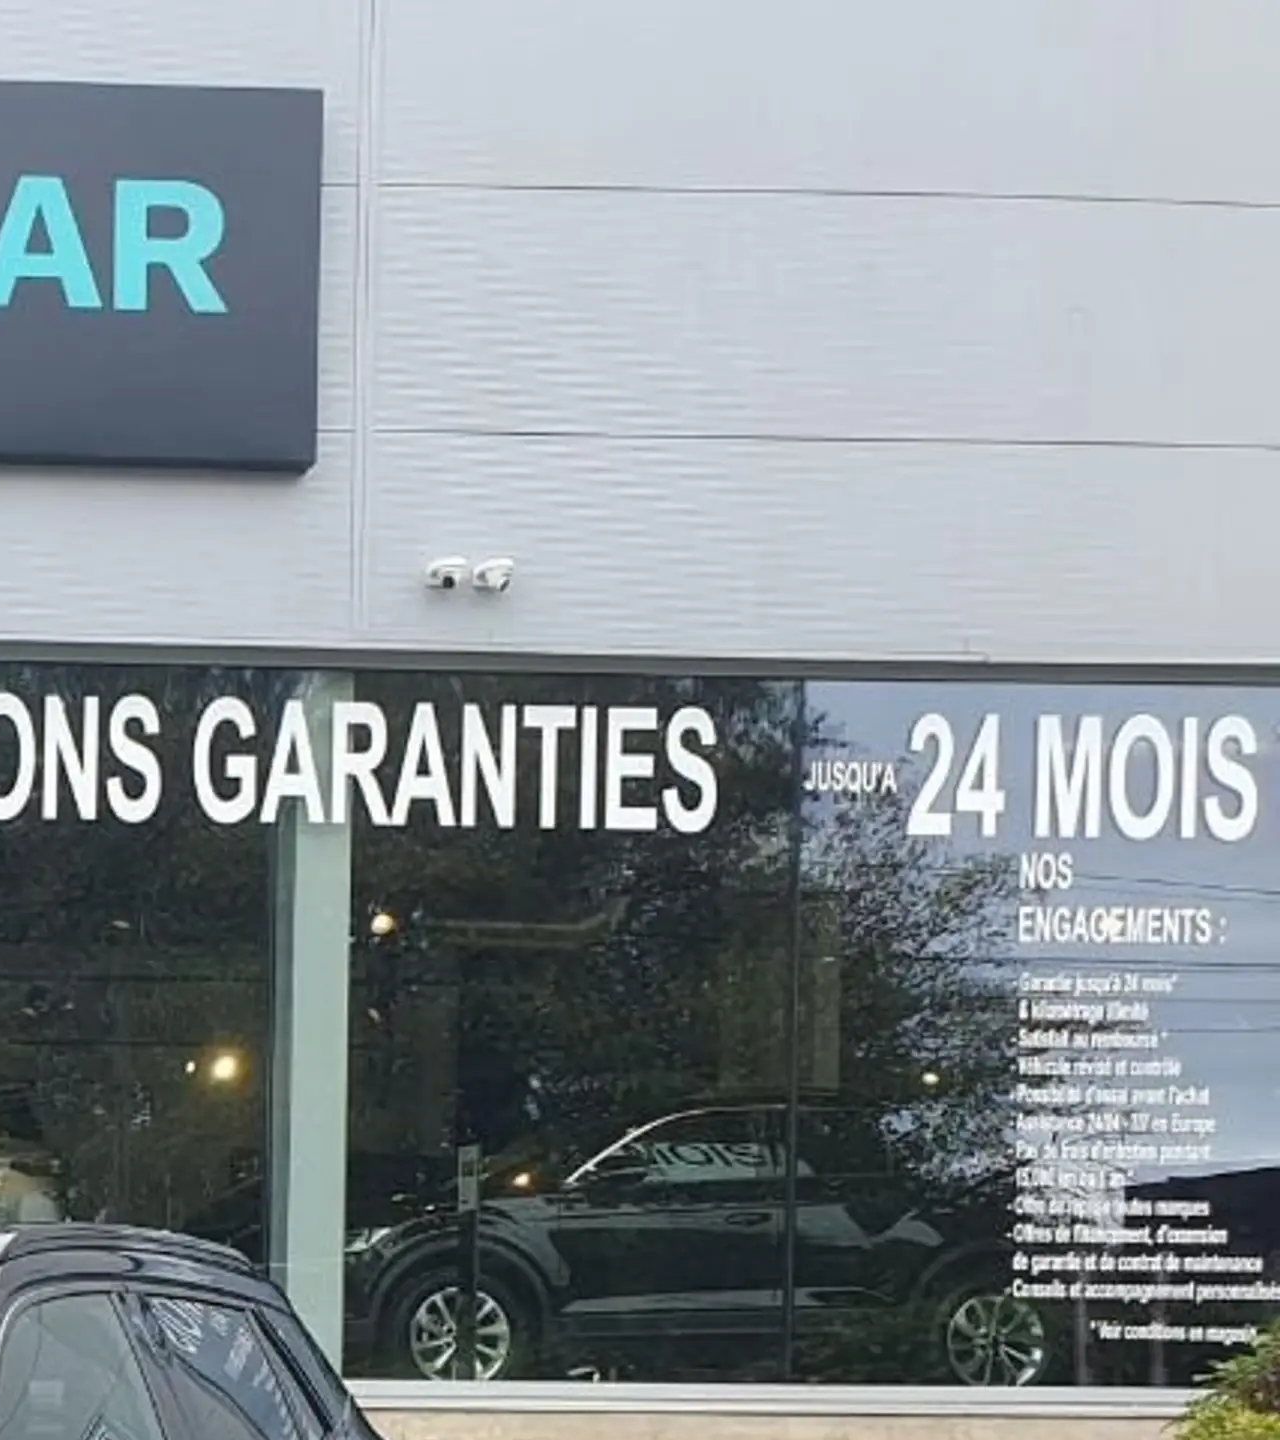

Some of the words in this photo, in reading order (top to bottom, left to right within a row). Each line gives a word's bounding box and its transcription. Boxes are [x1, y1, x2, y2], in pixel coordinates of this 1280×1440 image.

[193, 696, 718, 833] GARANTIES
[803, 760, 899, 798] JUSQU'A
[906, 713, 1005, 837] 24
[1034, 714, 1258, 842] MOIS
[1019, 852, 1073, 889] NOS
[1018, 906, 1213, 944] ENGAGEMENTS
